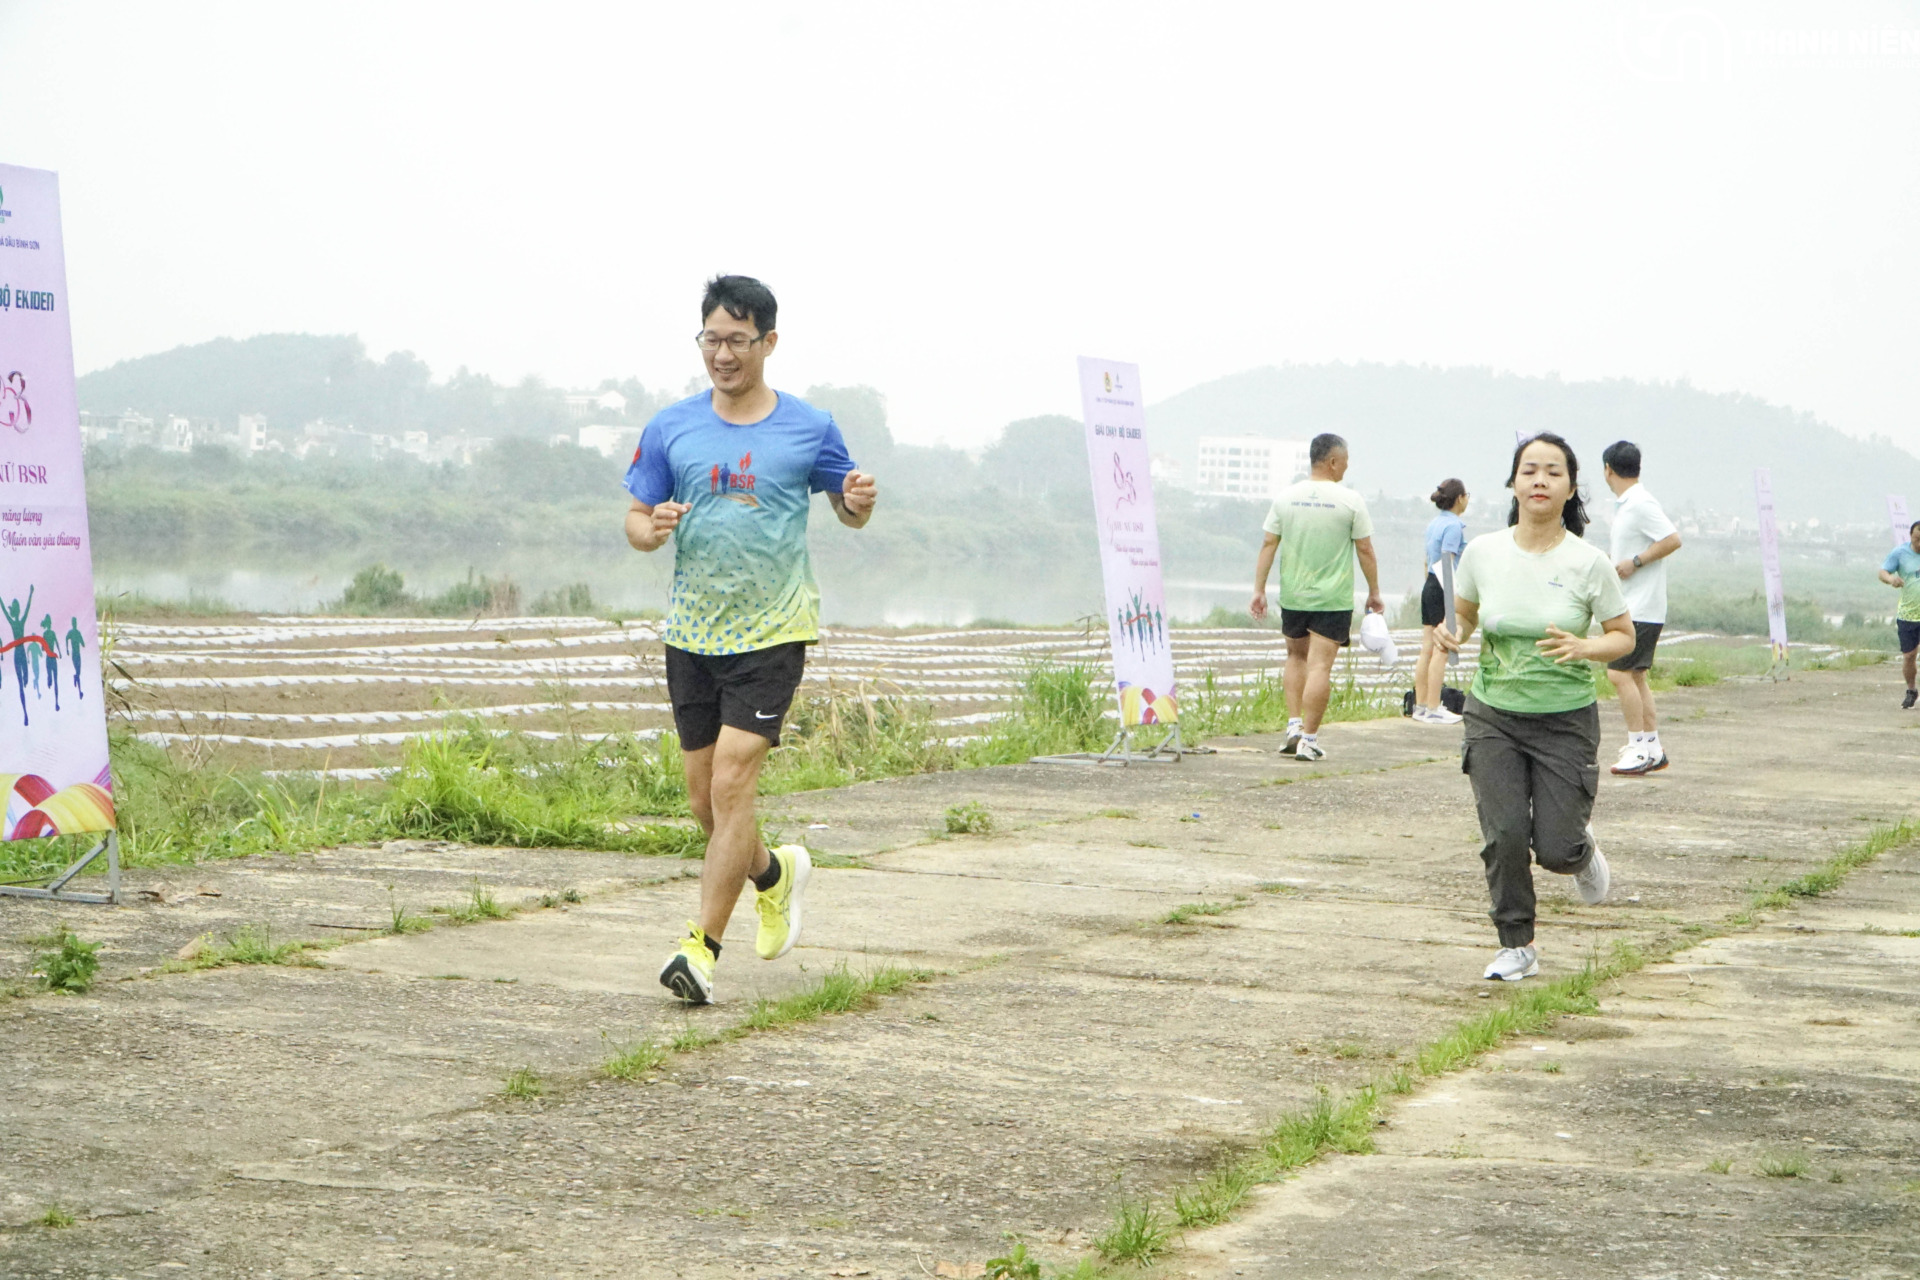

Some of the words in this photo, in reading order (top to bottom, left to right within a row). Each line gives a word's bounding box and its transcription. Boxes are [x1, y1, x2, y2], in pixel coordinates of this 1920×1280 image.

[16, 289, 54, 311] EKIDEN
[18, 464, 47, 484] BSR
[729, 473, 755, 490] BSR
[2, 509, 21, 526] năng
